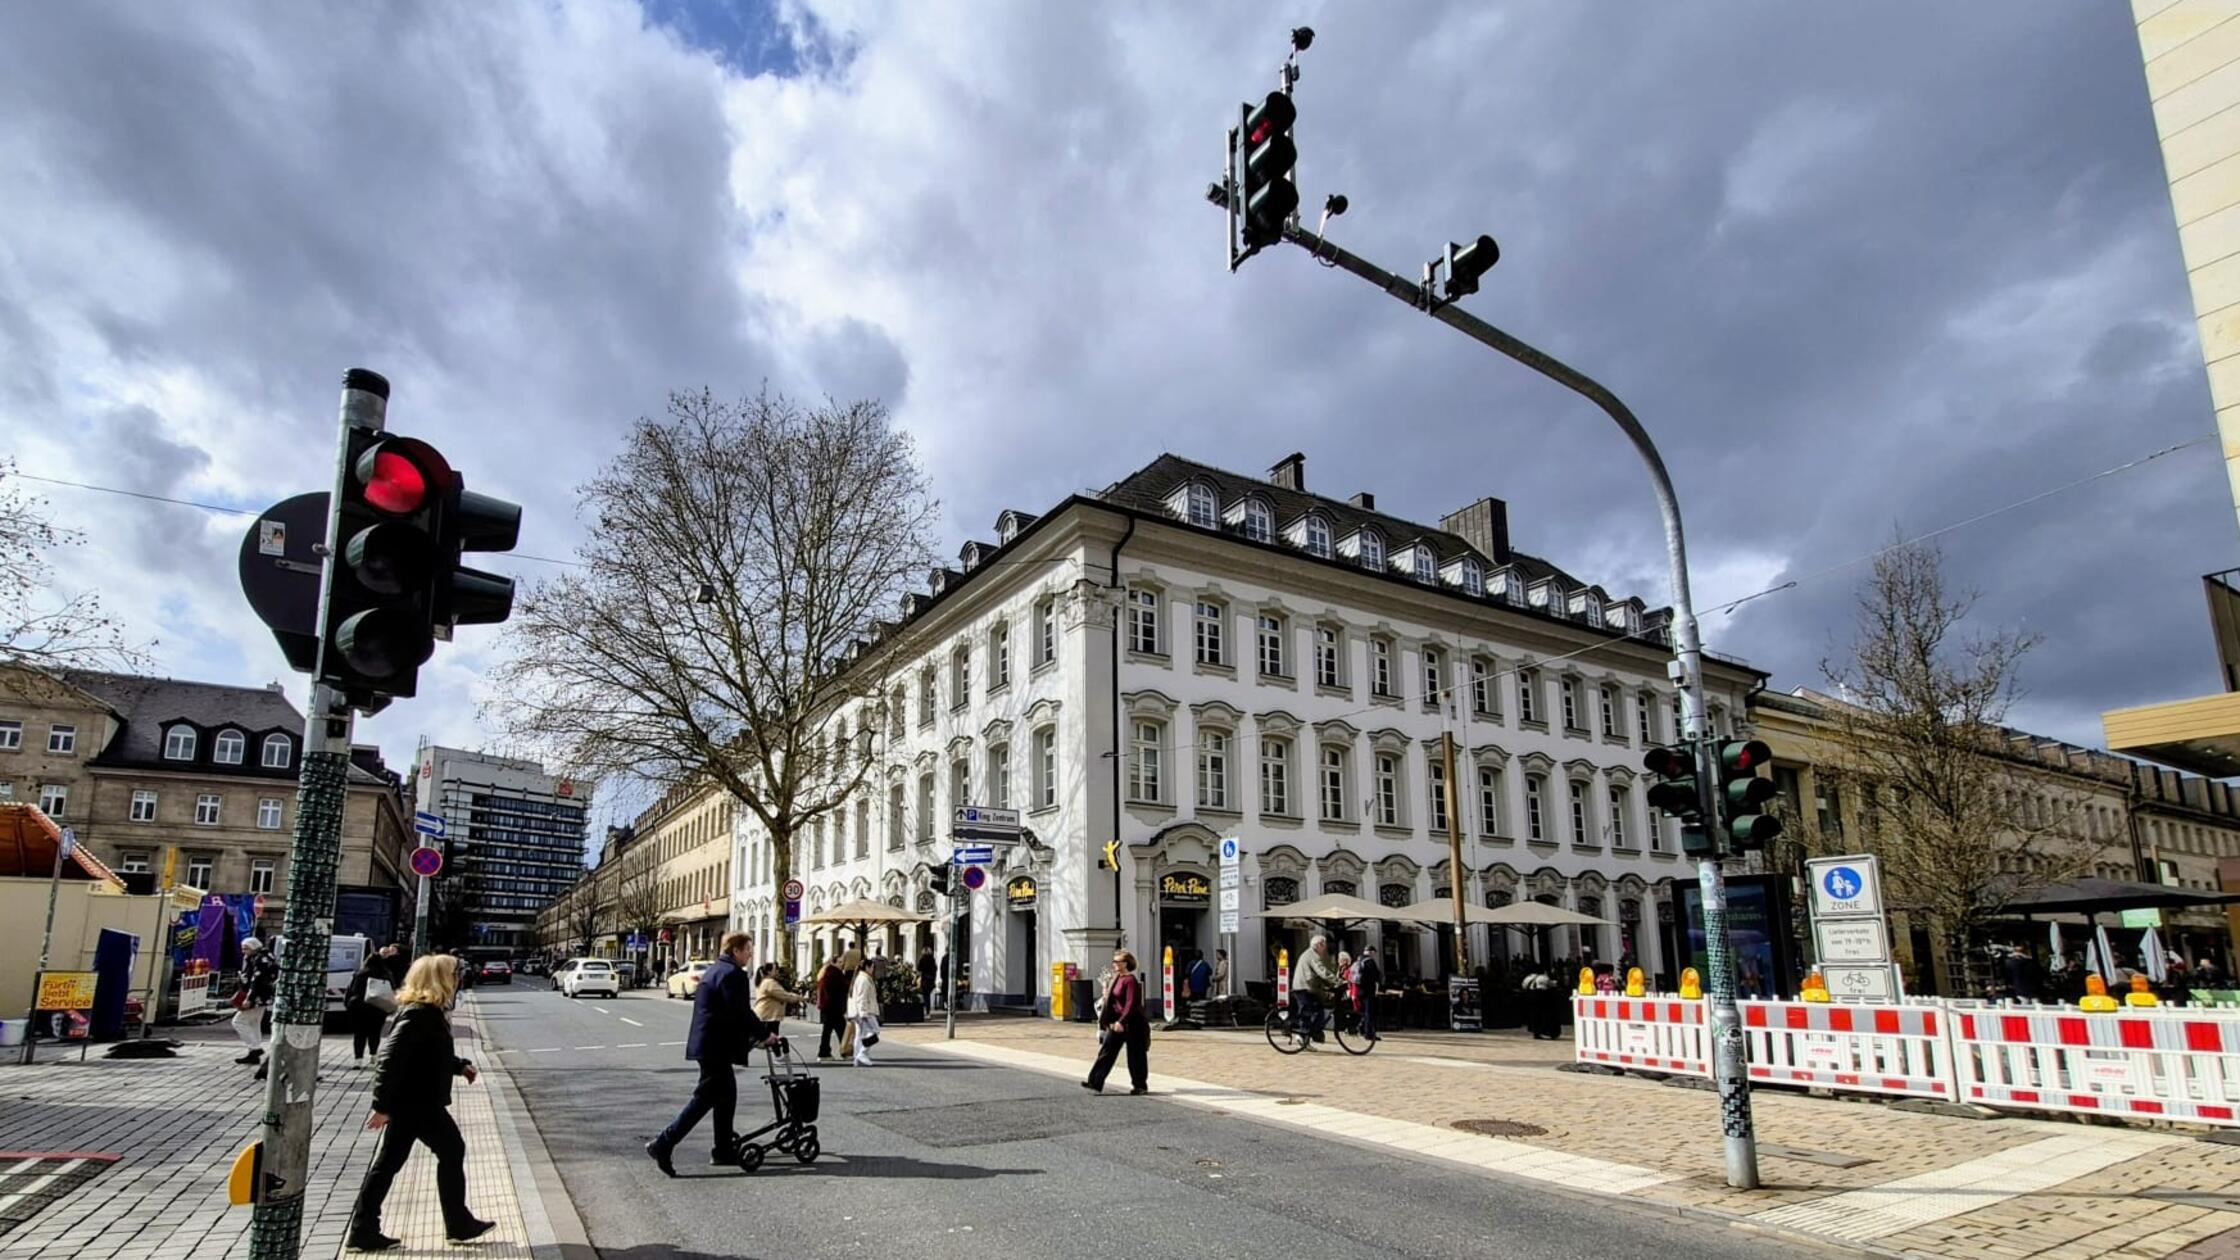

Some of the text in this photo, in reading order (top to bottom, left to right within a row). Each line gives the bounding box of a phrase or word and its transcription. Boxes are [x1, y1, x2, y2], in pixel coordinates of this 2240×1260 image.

[787, 884, 799, 895] 30
[1830, 900, 1861, 911] ZONE
[40, 998, 91, 1008] Service
